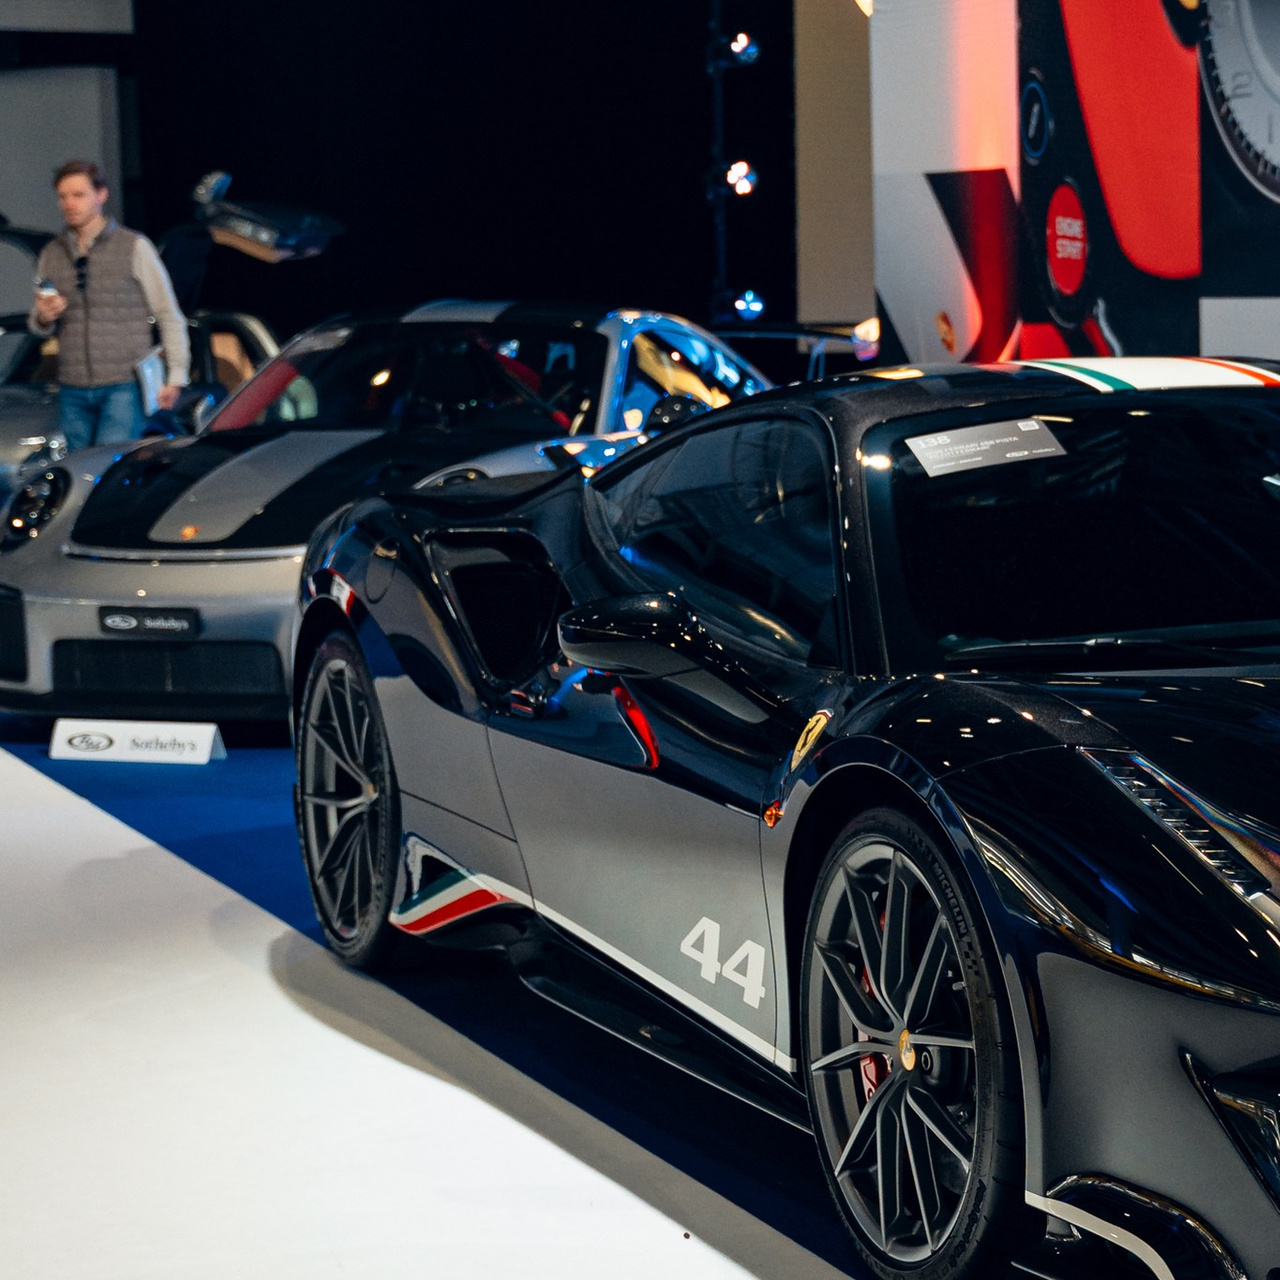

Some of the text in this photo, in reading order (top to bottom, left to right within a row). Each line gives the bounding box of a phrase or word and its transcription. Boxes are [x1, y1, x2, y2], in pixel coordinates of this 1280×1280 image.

[129, 735, 197, 756] Sotheby's
[931, 861, 969, 939] MICHELIN
[680, 916, 766, 1009] 44
